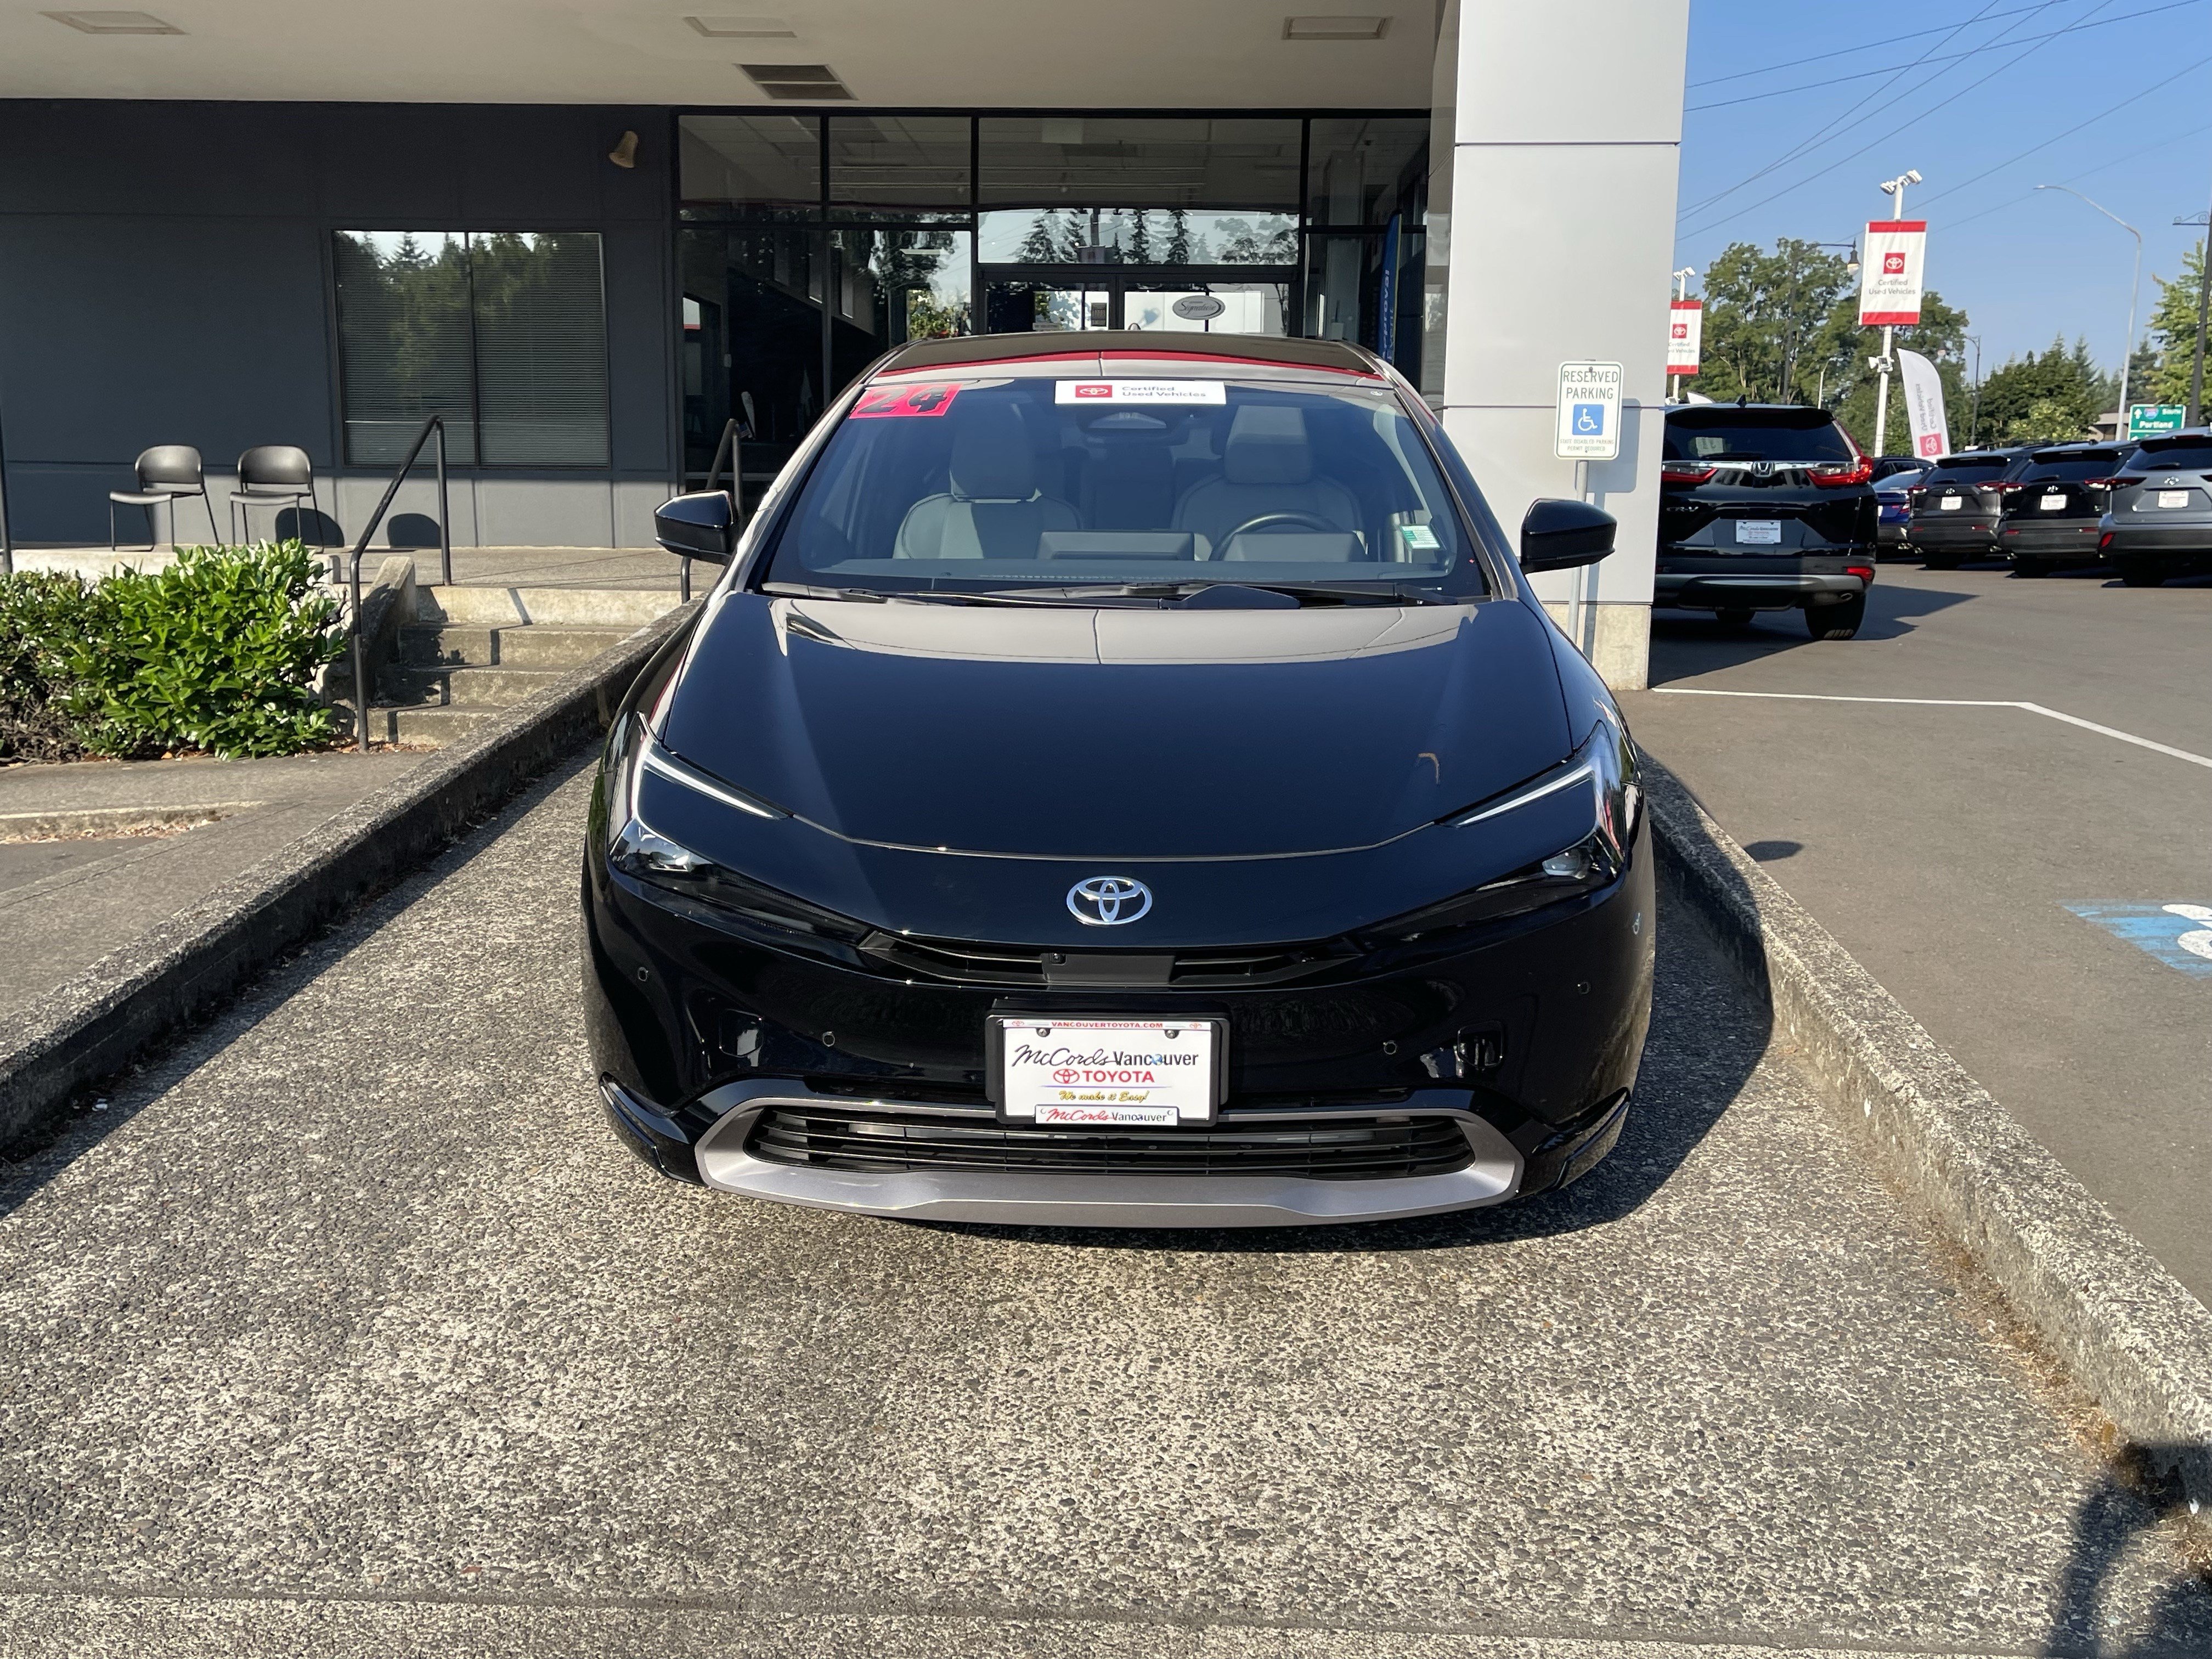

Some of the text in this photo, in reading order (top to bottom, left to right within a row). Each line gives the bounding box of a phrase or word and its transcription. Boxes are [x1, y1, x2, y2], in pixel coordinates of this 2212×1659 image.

[1563, 371, 1618, 382] RESERVED
[1566, 387, 1613, 399] PARKING
[857, 386, 947, 414] 24
[1011, 1044, 1199, 1067] McCords Vancouver
[1082, 1070, 1155, 1083] TOYOTA
[1058, 1090, 1150, 1103] We make it Easy!
